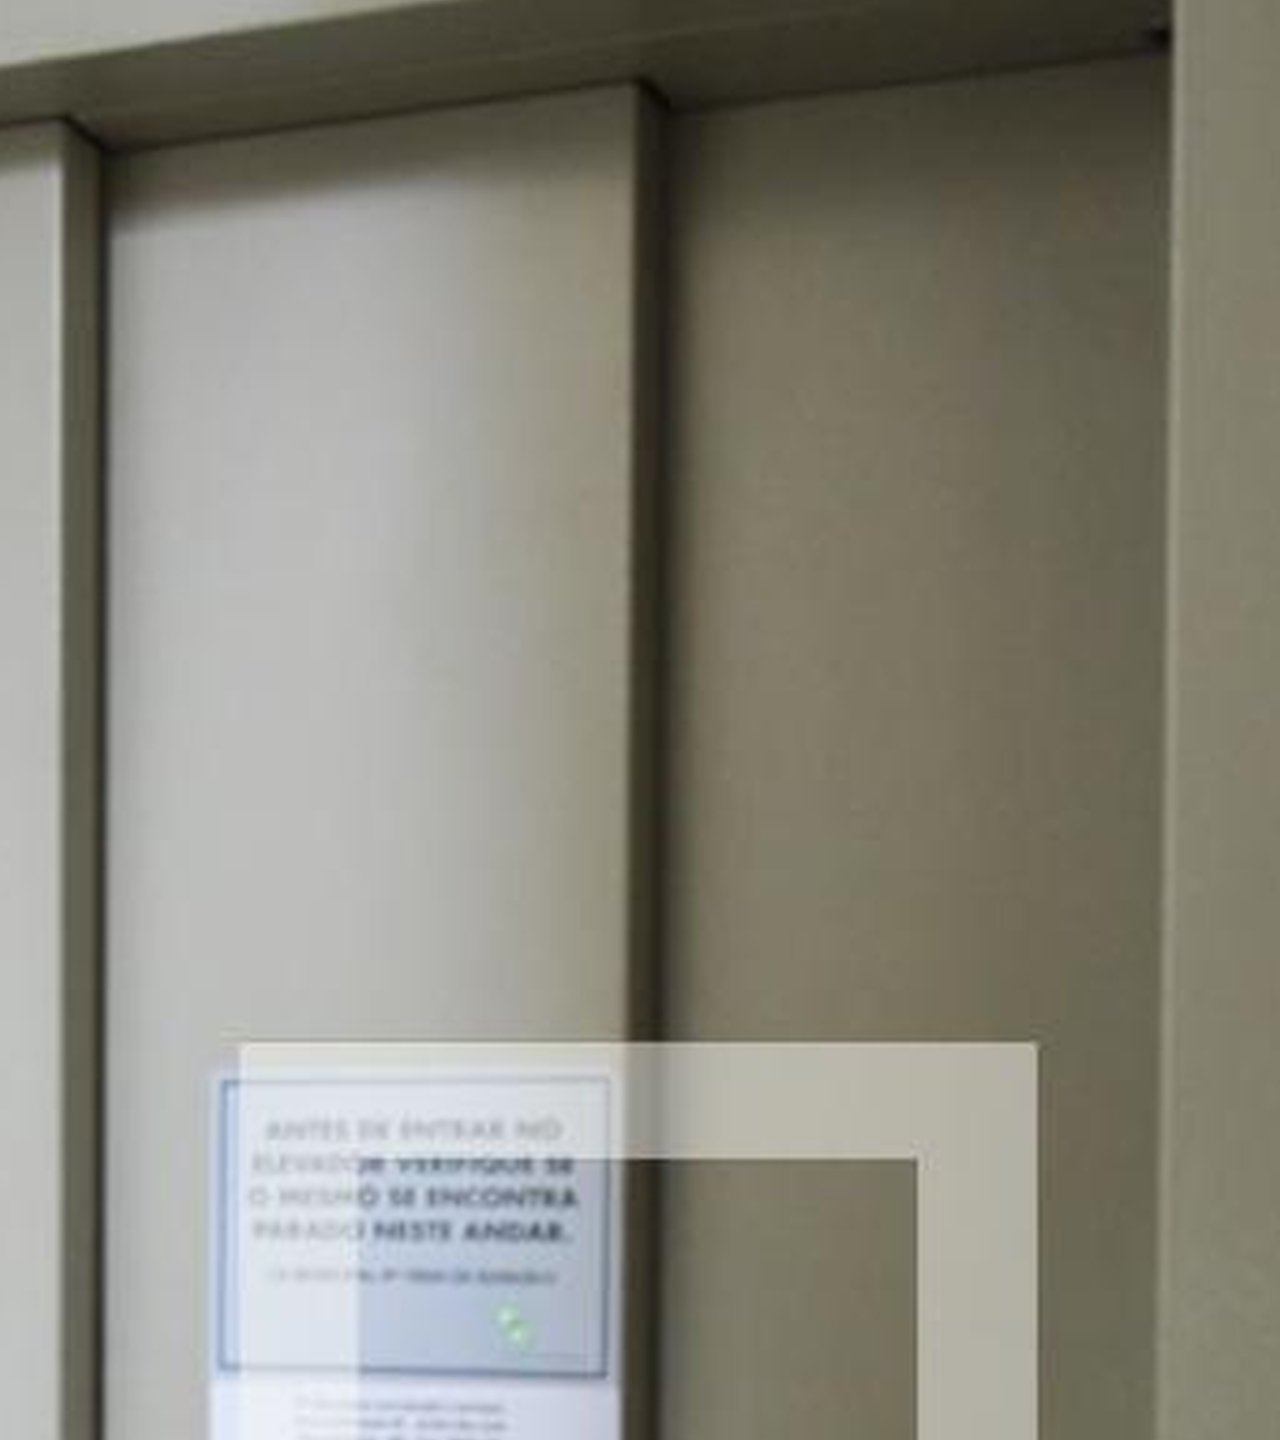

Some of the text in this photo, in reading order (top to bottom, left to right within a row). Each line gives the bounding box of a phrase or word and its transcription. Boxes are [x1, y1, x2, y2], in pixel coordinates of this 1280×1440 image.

[268, 1119, 563, 1141] ANTES DE ENTRAR NO
[252, 1153, 575, 1174] ELEVADOR VERIFIQUE SE
[250, 1186, 578, 1208] O MESMO SE ENCONTRA
[253, 1221, 573, 1243] PARADO NESTE ANDAR.
